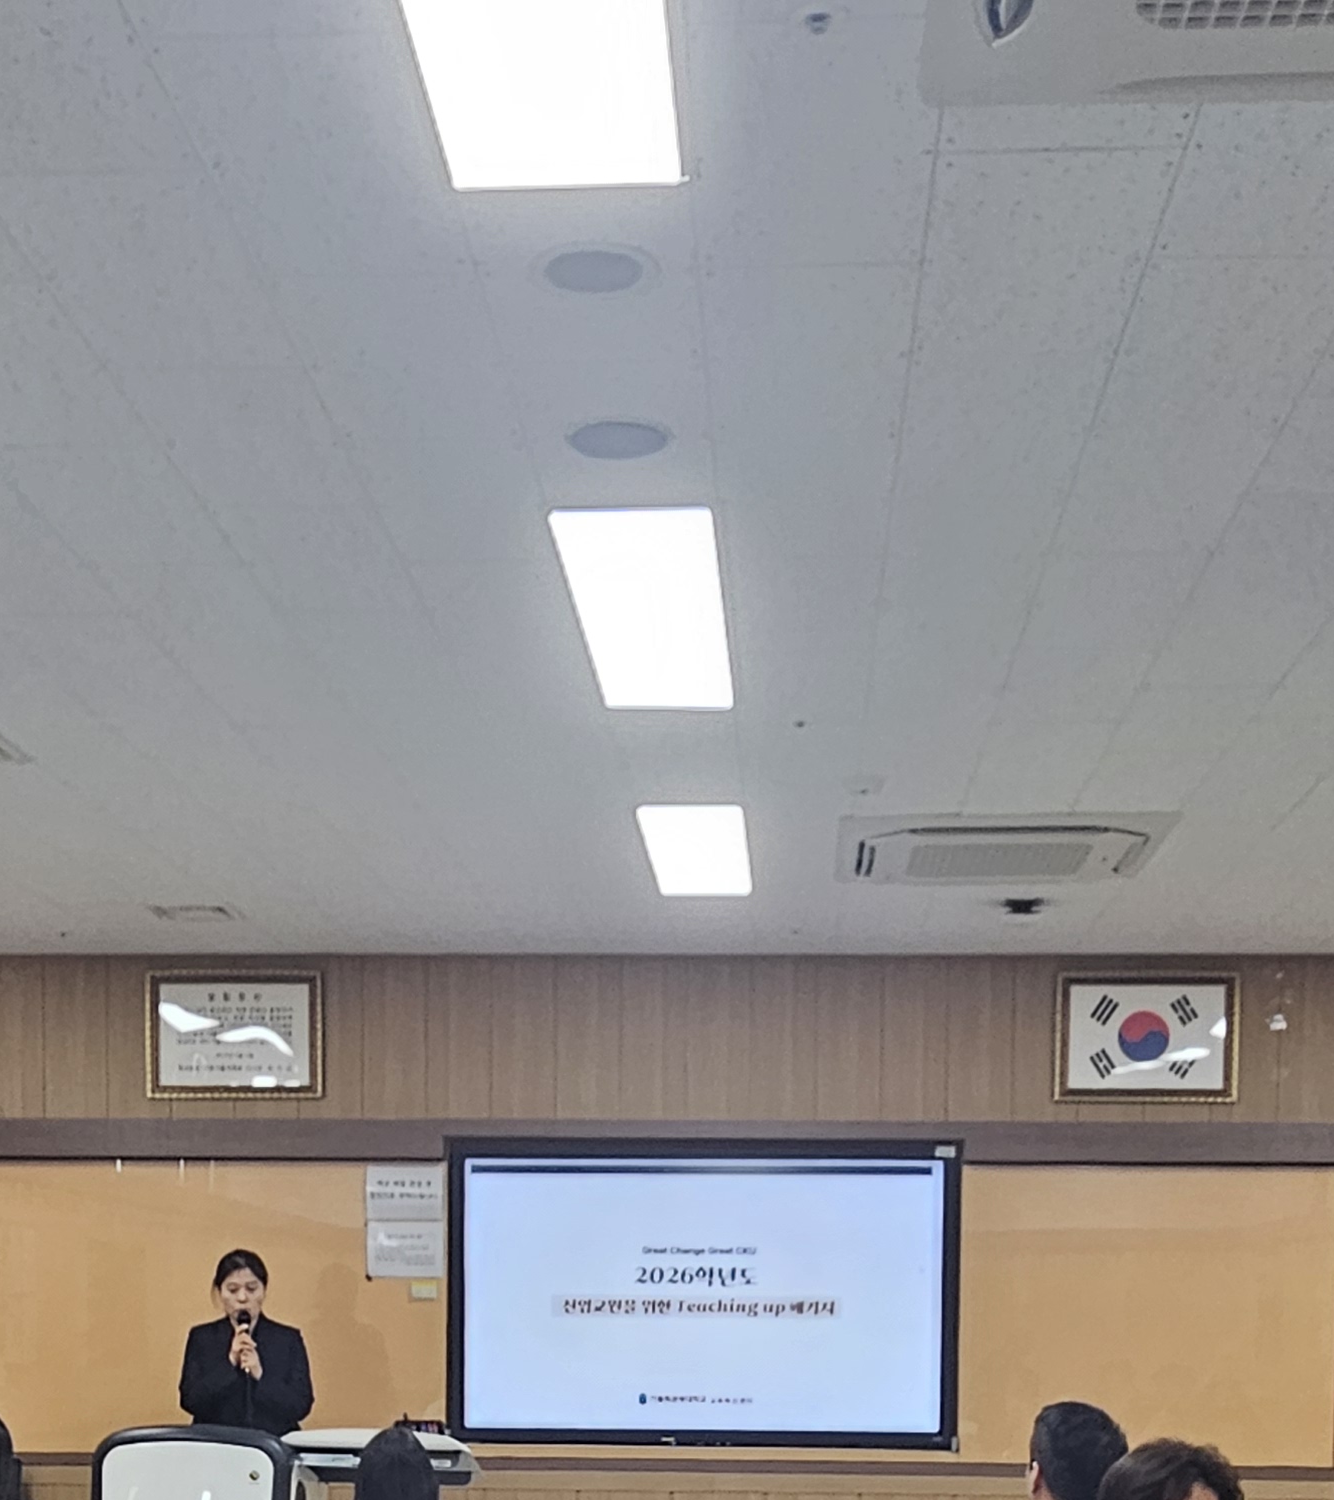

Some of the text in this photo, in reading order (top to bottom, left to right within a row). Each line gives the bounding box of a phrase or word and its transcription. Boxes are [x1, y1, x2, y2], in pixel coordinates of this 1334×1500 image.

[635, 1266, 758, 1287] 2026학년도
[677, 1298, 758, 1317] Teaching
[763, 1301, 786, 1317] up
